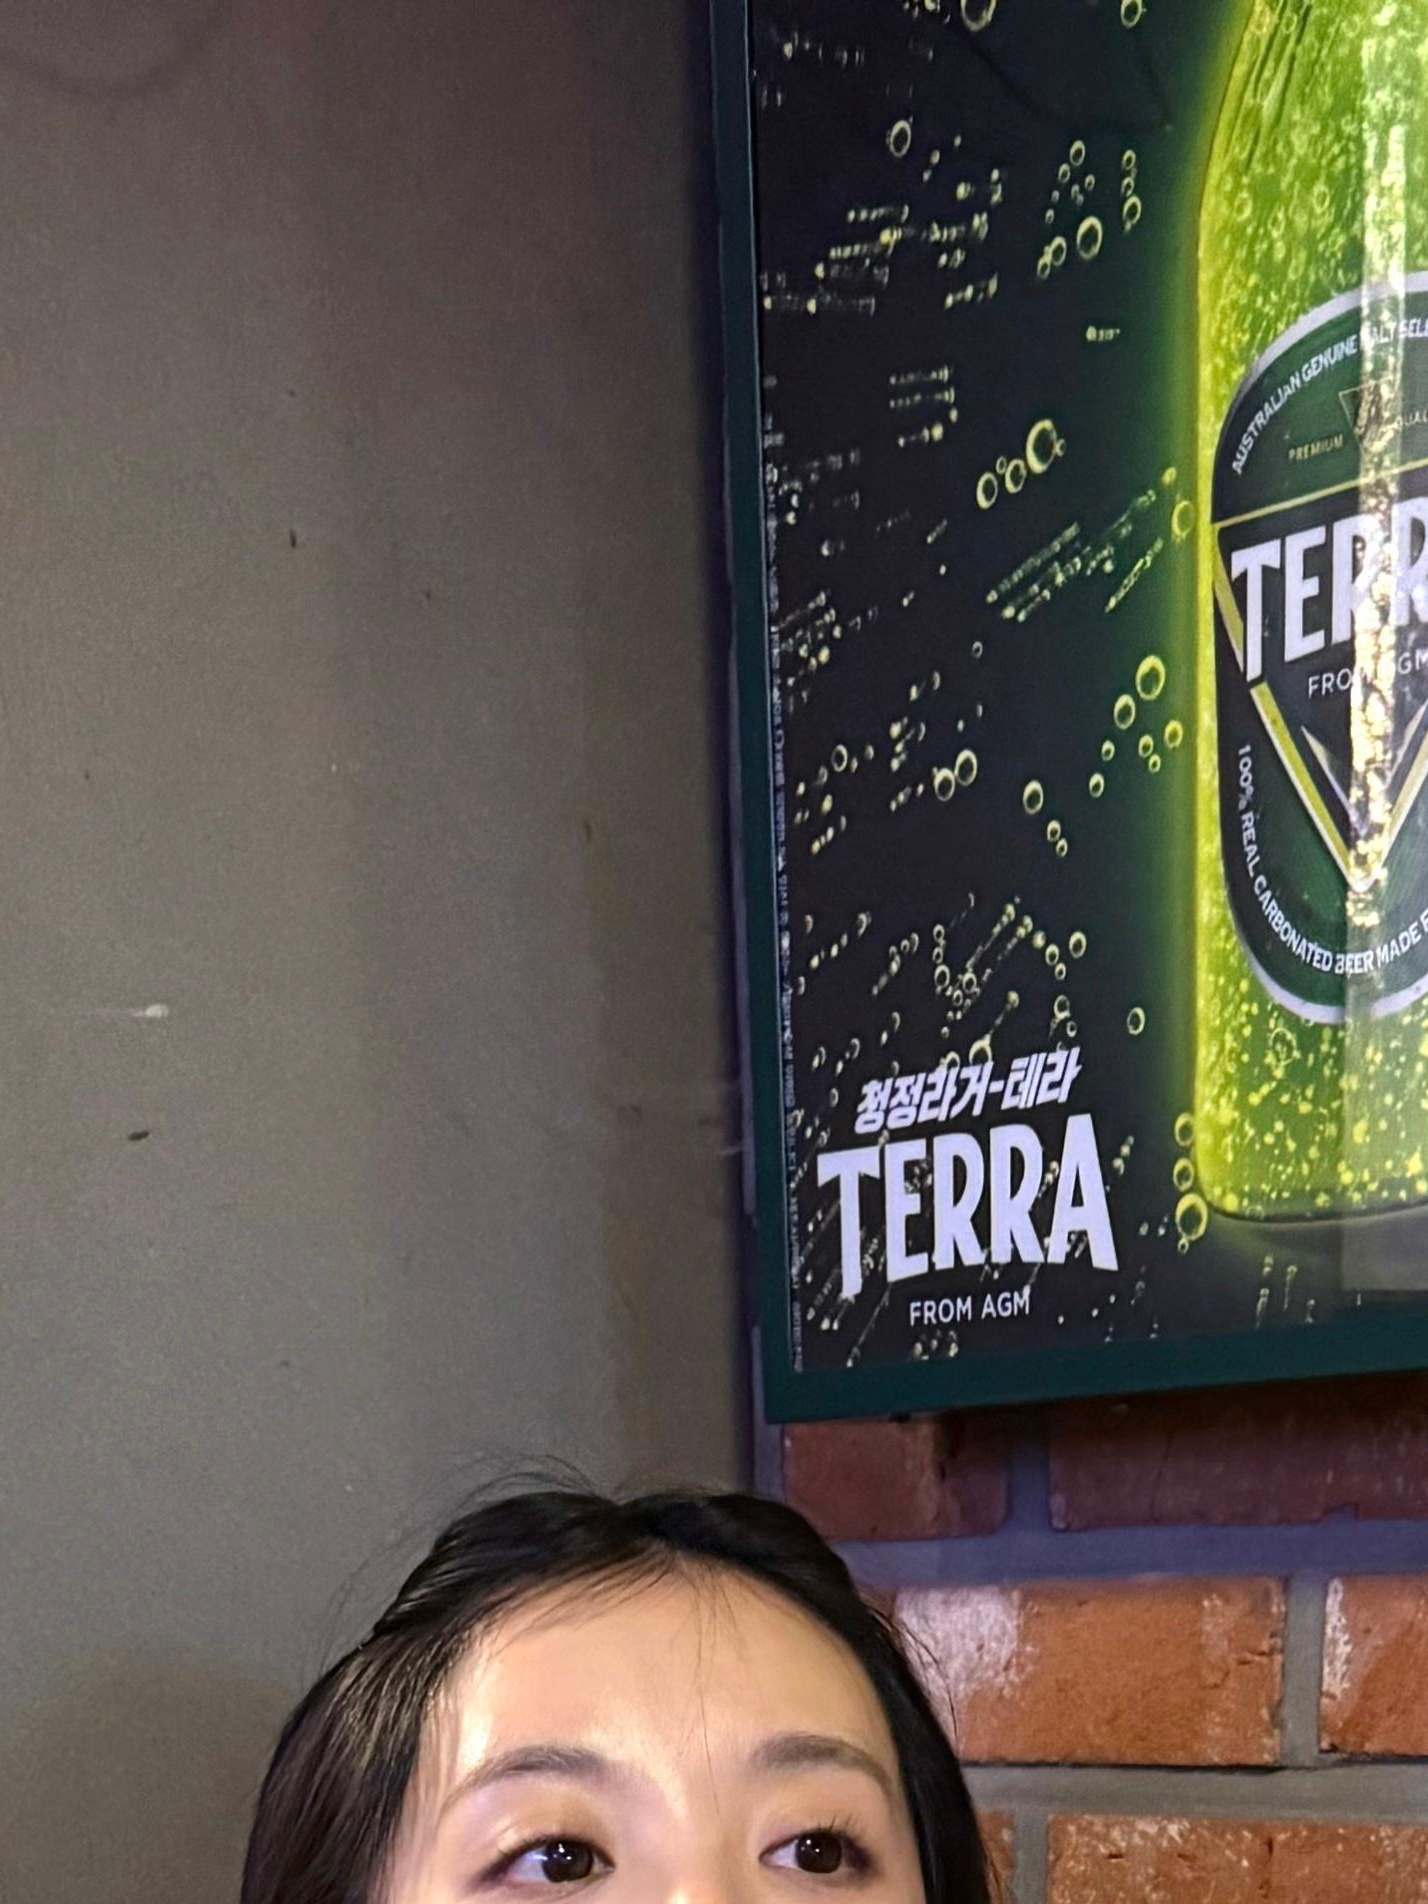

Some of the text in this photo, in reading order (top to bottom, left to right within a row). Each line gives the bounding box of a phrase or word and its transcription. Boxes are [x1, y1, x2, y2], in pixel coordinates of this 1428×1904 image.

[1232, 373, 1301, 476] AUSTRALIAN
[1301, 333, 1359, 382] GENUINE
[1288, 433, 1345, 462] PREMIUM
[1237, 743, 1255, 812] 100%
[1240, 811, 1263, 878] REAL
[1253, 875, 1333, 974] CARBONATED
[1374, 922, 1422, 968] MADE
[1334, 950, 1374, 975] BEER
[853, 1046, 1083, 1135] 청정라거-테라
[816, 1112, 1119, 1302] TERRA
[908, 1285, 1031, 1327] FROM AGM
